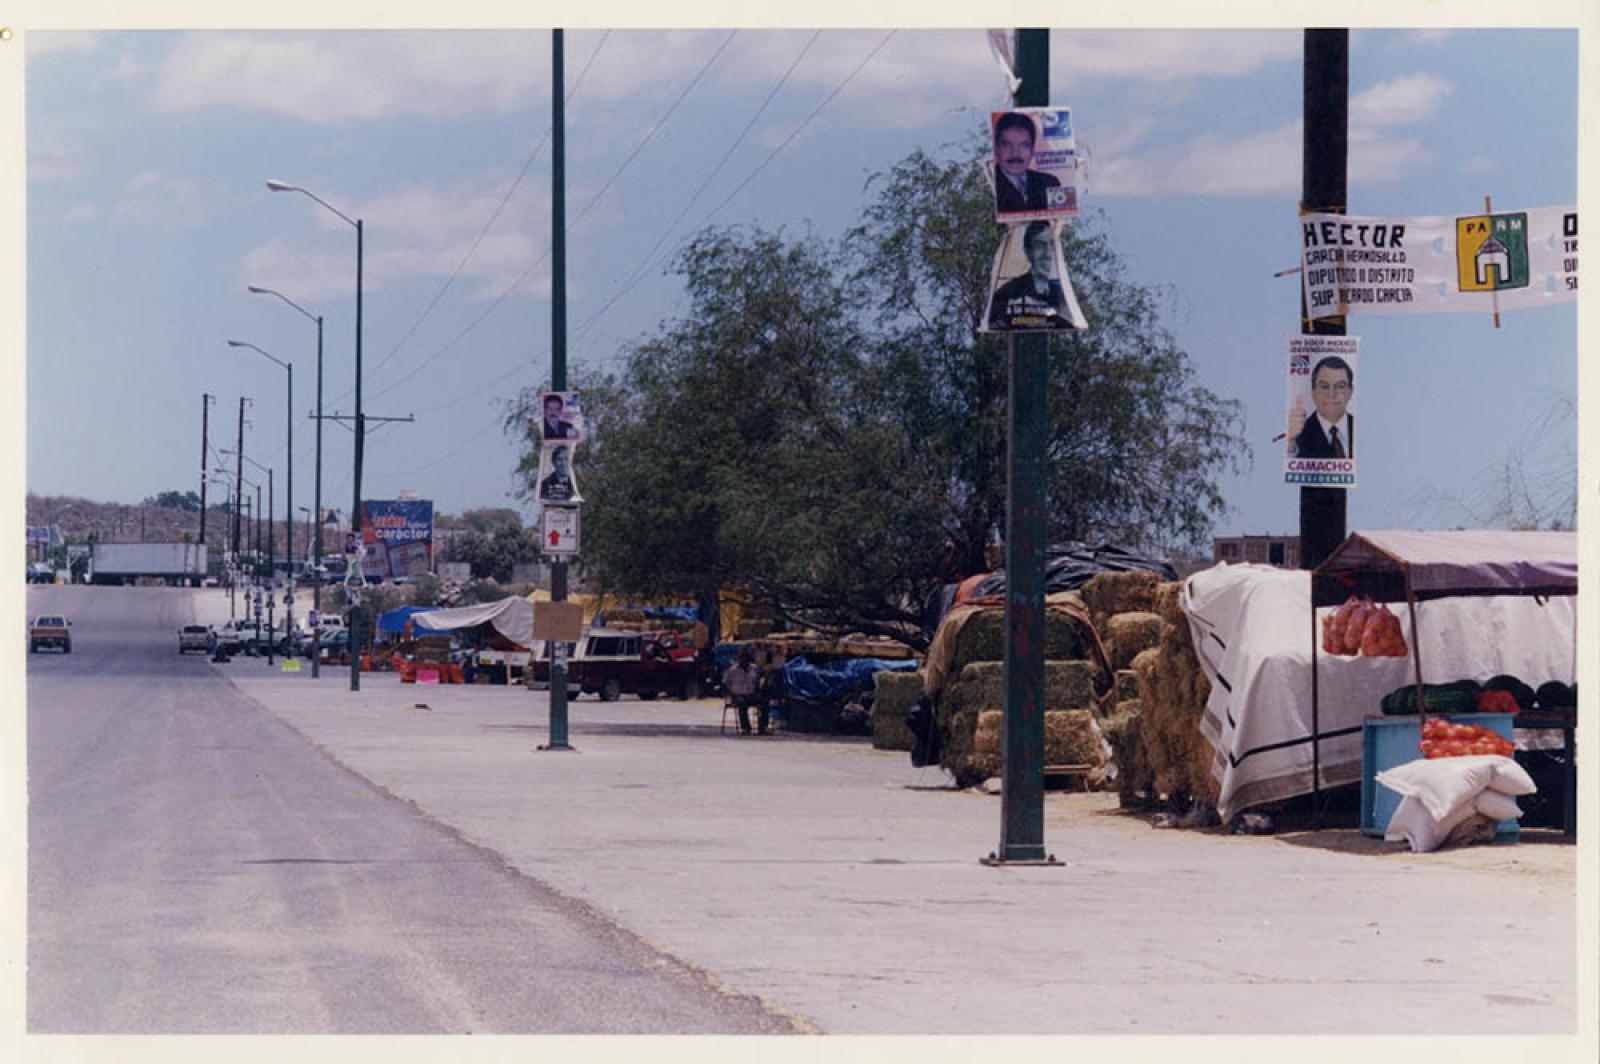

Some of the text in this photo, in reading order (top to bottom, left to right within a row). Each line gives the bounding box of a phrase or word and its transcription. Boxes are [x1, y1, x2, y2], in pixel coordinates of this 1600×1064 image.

[1466, 219, 1521, 233] PARM
[1303, 222, 1405, 248] HECTOR
[1367, 268, 1414, 284] DISTRITO
[1288, 460, 1352, 472] CAMACHO
[1287, 473, 1352, 483] PRESIDENTE
